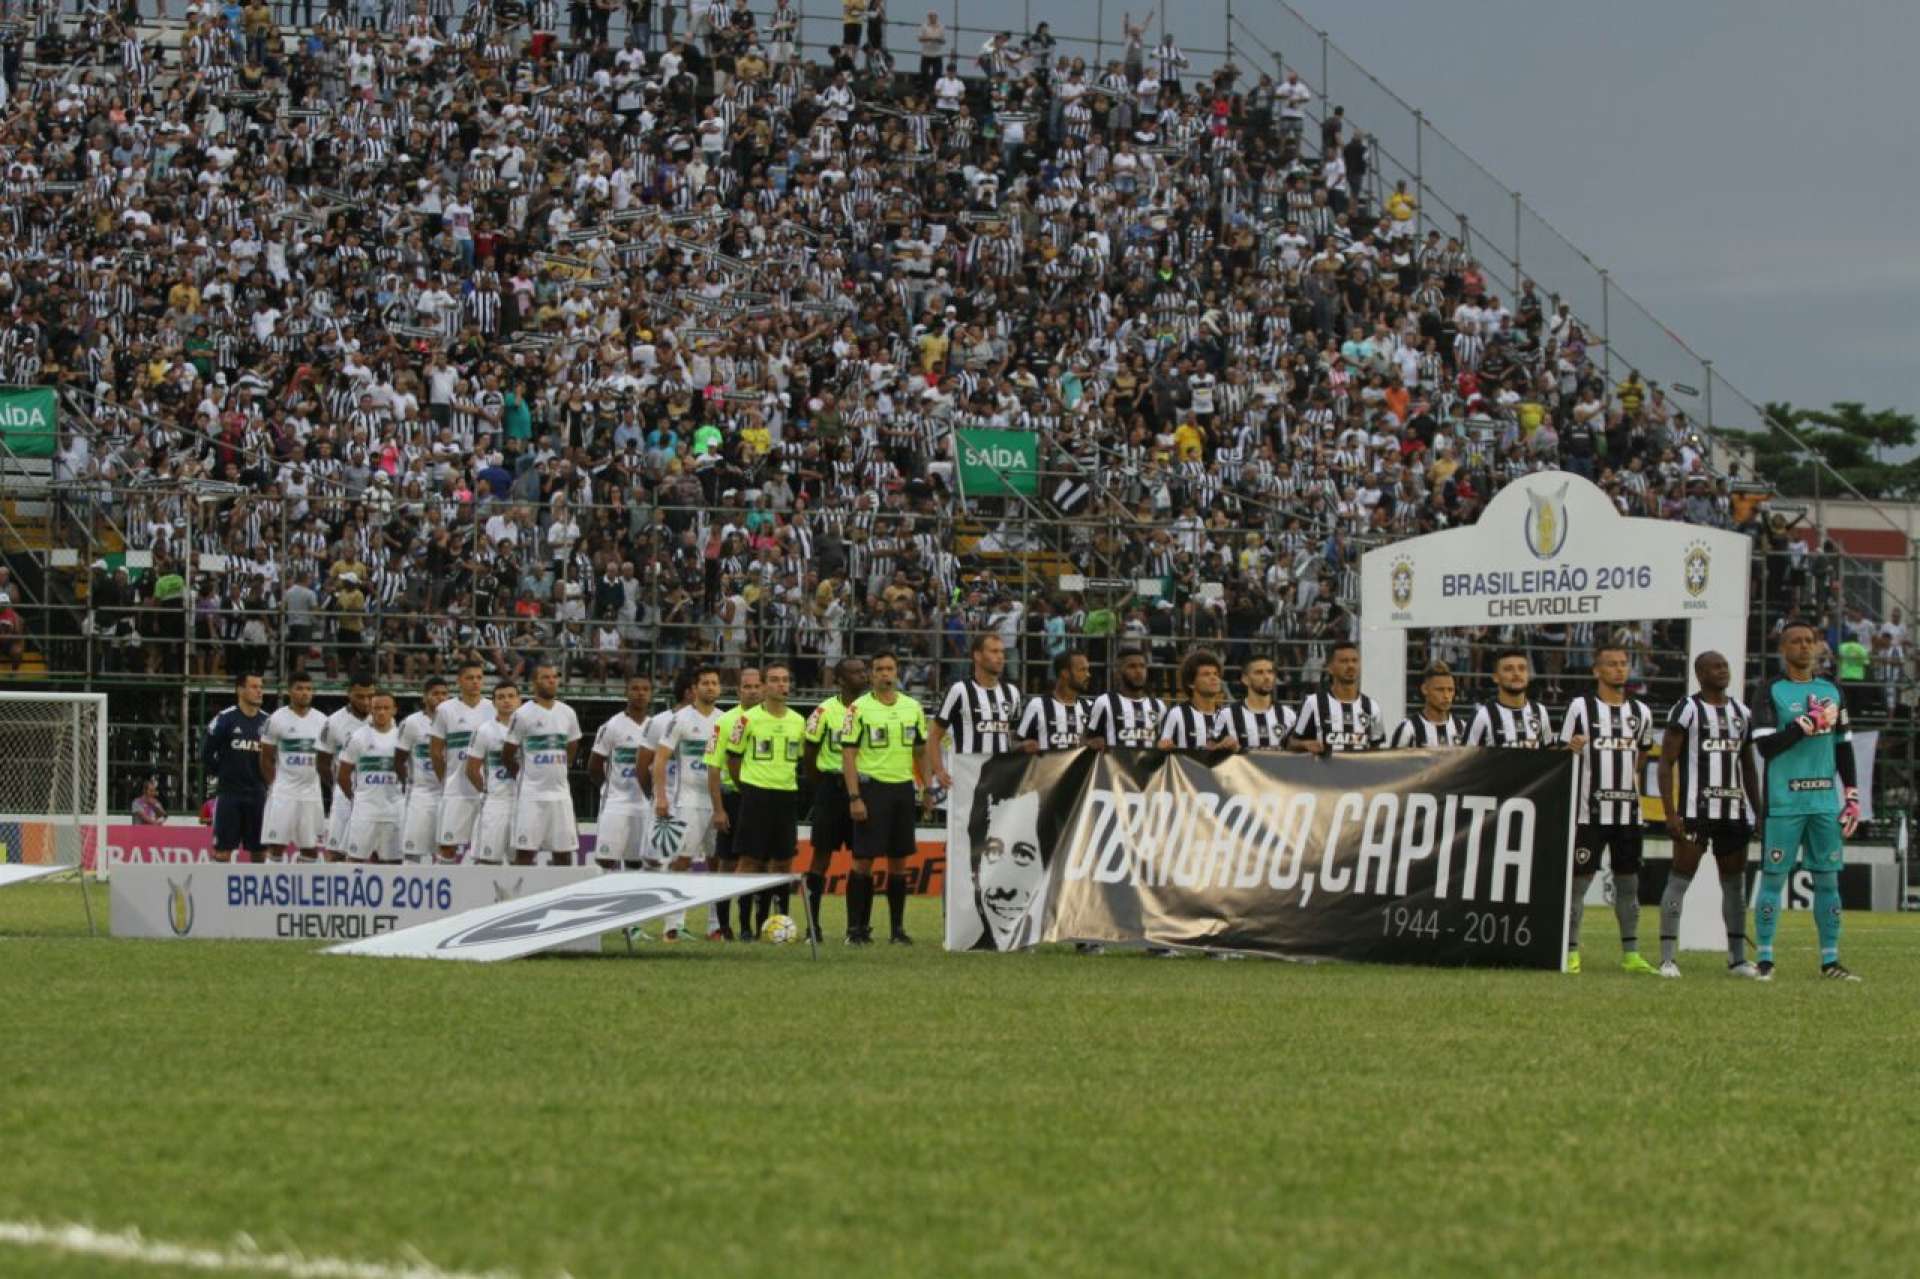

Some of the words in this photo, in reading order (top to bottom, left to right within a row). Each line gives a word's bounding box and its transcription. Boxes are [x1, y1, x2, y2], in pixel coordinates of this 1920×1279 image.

[965, 444, 1028, 468] SAÍDA
[1442, 564, 1588, 597] BRASILEIRÃO
[1596, 566, 1651, 590] 2016
[1487, 595, 1602, 617] CHEVROLET
[1051, 733, 1080, 745] CAIX
[1594, 738, 1637, 750] CAIXA
[1320, 792, 1536, 904] CAPITA
[227, 868, 384, 909] BRASILEIRÃO
[392, 877, 453, 911] 2016
[277, 912, 399, 939] CHEVROLET
[1381, 907, 1440, 940] 1944
[1463, 911, 1533, 947] 2016
